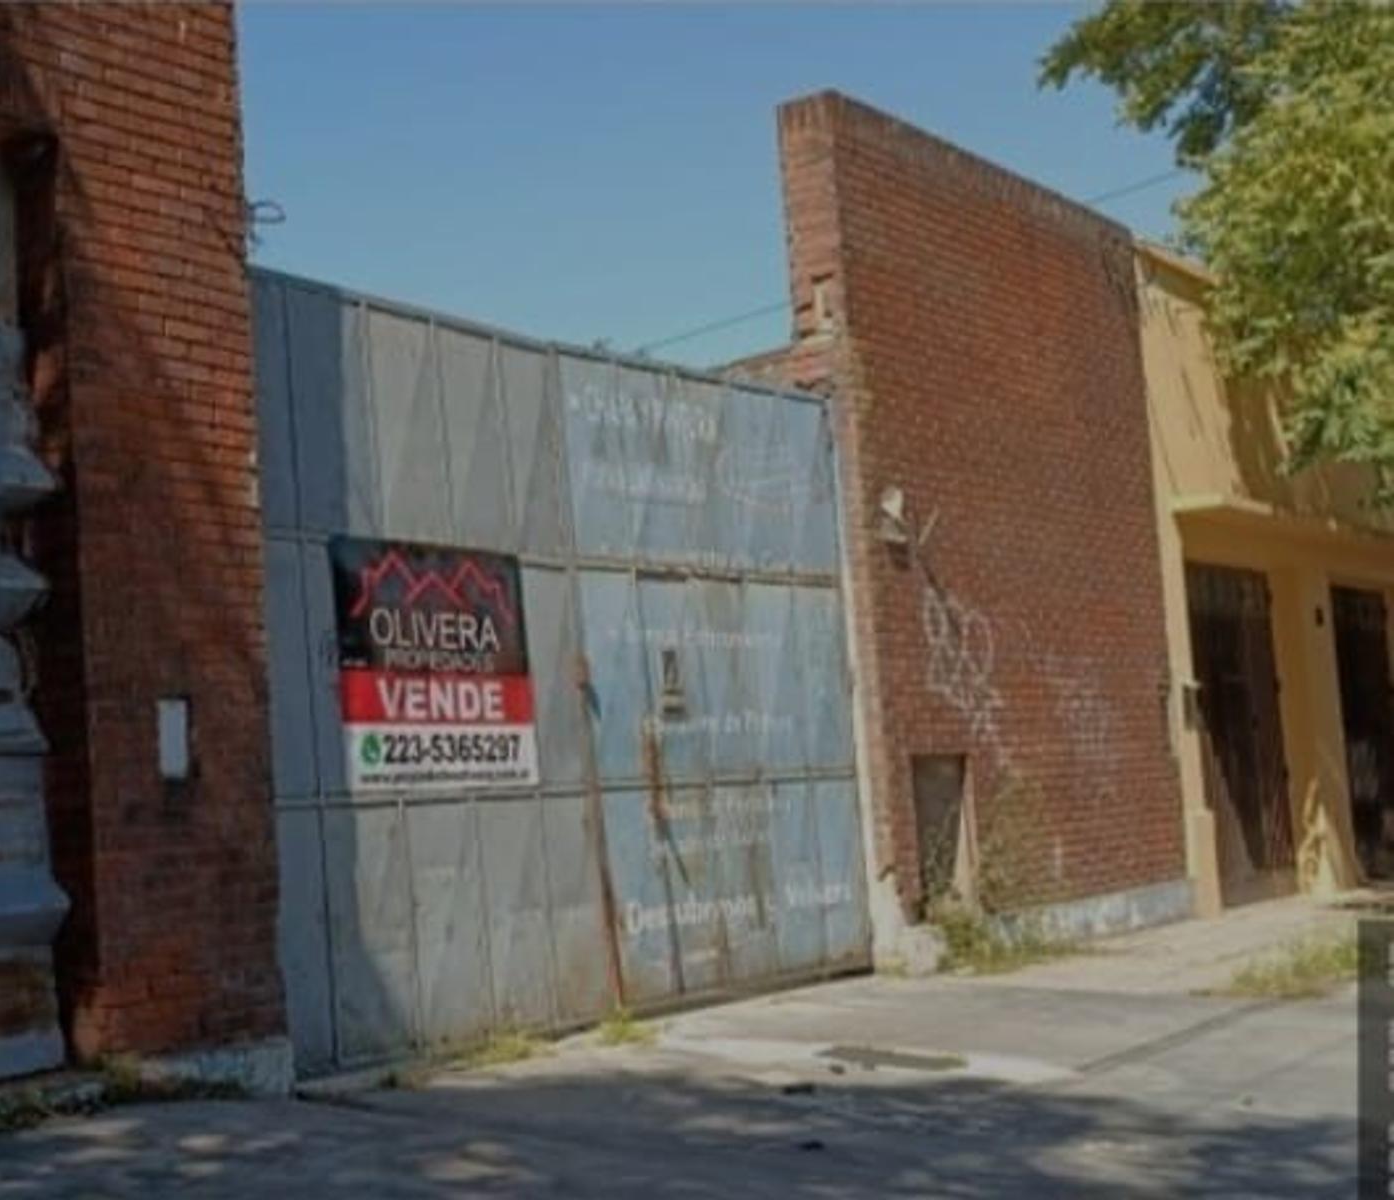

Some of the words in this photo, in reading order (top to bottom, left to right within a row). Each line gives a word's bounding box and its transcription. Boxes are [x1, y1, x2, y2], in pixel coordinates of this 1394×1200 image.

[369, 607, 501, 652] OLIVERA
[376, 675, 504, 720] VENDE
[383, 733, 521, 765] 223-5365297
